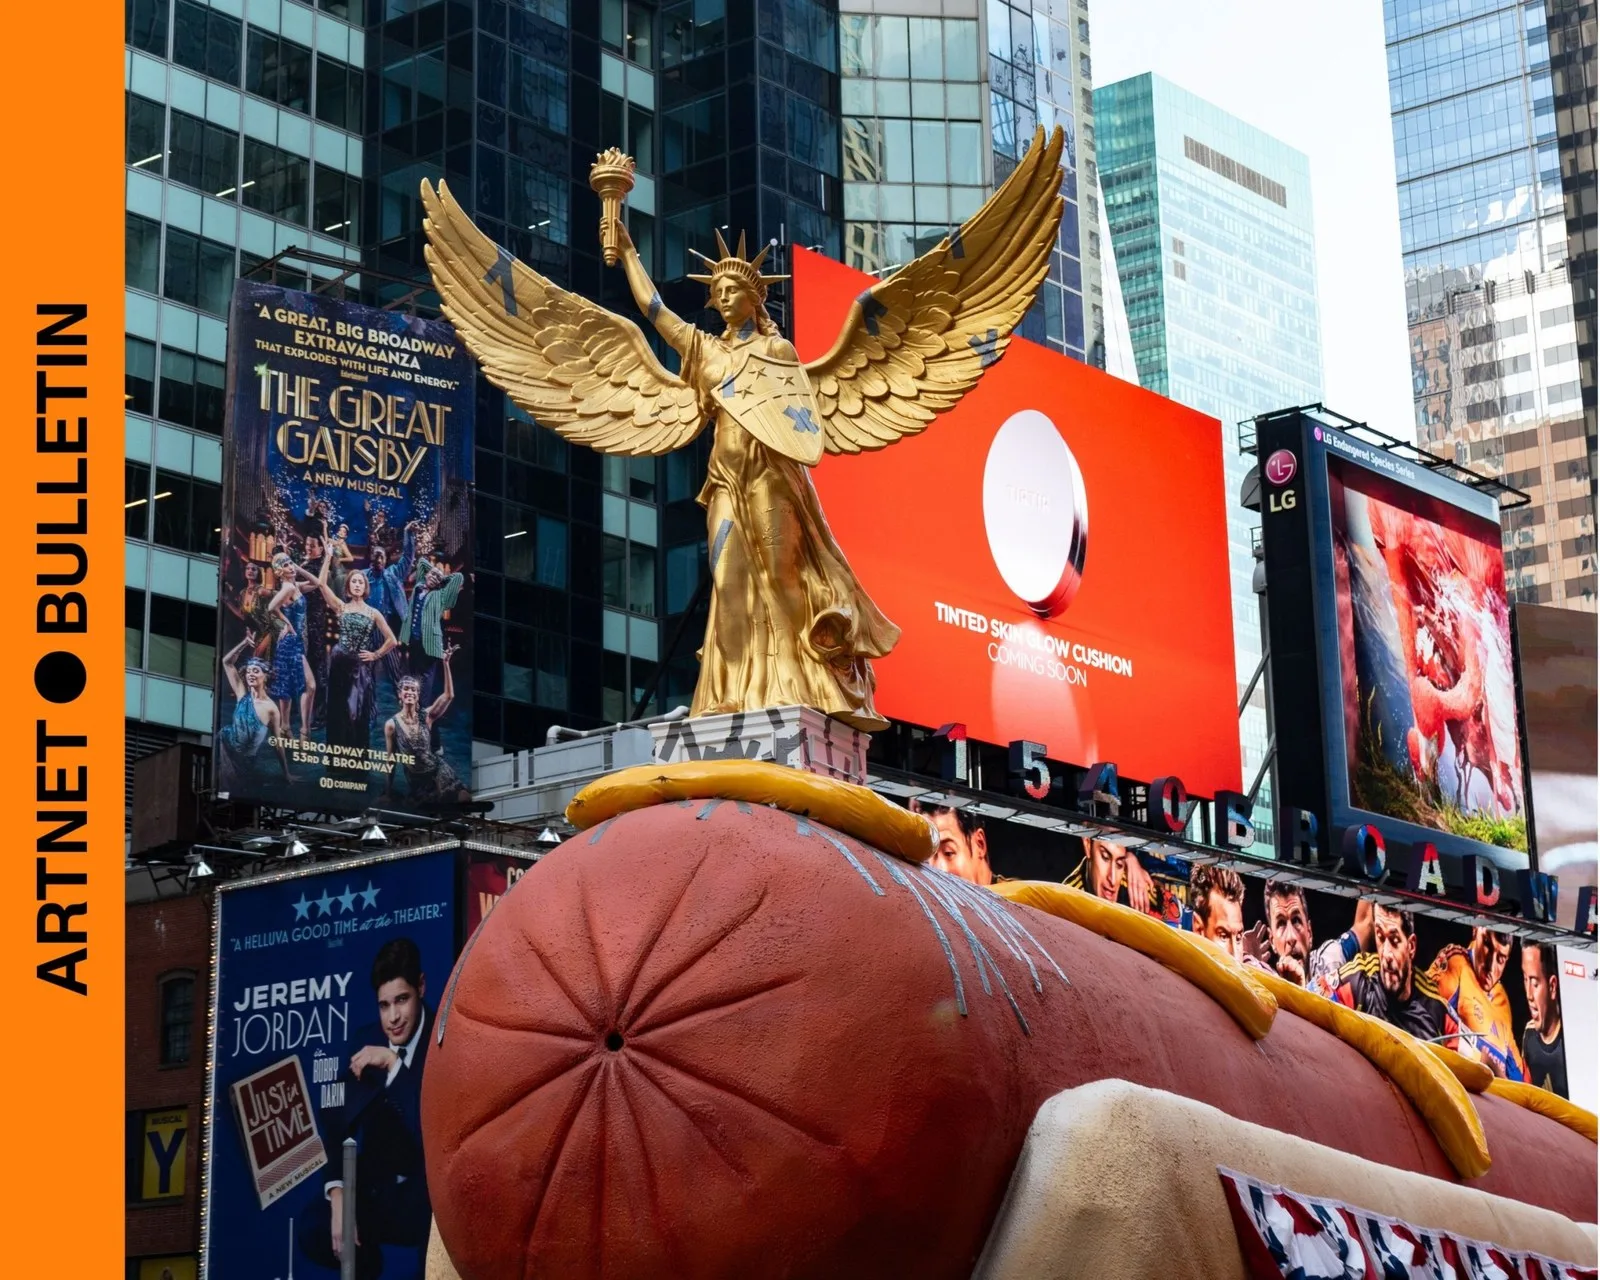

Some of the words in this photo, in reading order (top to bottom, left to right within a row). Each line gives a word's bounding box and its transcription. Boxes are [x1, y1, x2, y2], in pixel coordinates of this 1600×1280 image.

[254, 302, 271, 320] "A
[274, 308, 332, 335] GREAT,
[335, 321, 364, 340] BIG
[368, 328, 456, 360] BROADWAY
[294, 330, 421, 371] EXTRAVAGANZA
[255, 338, 283, 354] THAT
[284, 346, 338, 366] EXPLODES
[340, 357, 367, 373] WITH
[368, 361, 389, 377] LIFE
[390, 369, 413, 382] AND
[414, 374, 460, 391] ENERGY."
[254, 365, 320, 421] THE
[328, 385, 452, 447] GREAT
[276, 420, 428, 484] GATSBY
[1322, 431, 1332, 445] LG
[1333, 435, 1370, 462] Endangered
[1370, 452, 1395, 471] Species
[1395, 464, 1415, 480] Series
[303, 470, 313, 482] A
[315, 472, 345, 489] NEW
[347, 477, 404, 500] MUSICAL
[1269, 489, 1296, 512] LG
[934, 601, 988, 634] TINTED
[990, 618, 1025, 645] SKIN
[1026, 629, 1070, 659] GLOW
[1072, 643, 1132, 678] CUSHION
[987, 642, 1045, 675] COMING
[1047, 661, 1088, 688] SOON
[276, 737, 300, 750] THE
[302, 740, 365, 758] BROADWAY
[367, 749, 416, 766] THEATRE
[292, 751, 320, 764] 53RD
[321, 756, 330, 766] &
[332, 756, 395, 774] BROADWAY
[334, 780, 368, 792] COMPANY
[934, 723, 1187, 833] 1540
[244, 930, 289, 950] HELLUVA
[291, 923, 331, 942] GOOD
[333, 917, 358, 936] TIME
[359, 918, 373, 931] at
[374, 913, 393, 929] the
[393, 902, 448, 925] THEATER."
[233, 971, 353, 1012] JEREMY
[231, 1001, 349, 1057] JORDAN
[313, 1056, 339, 1083] BOBBY
[249, 1080, 288, 1127] JUST
[286, 1083, 299, 1102] in
[320, 1082, 345, 1109] DARIN
[249, 1102, 312, 1153] TIME
[147, 1128, 187, 1194] Y
[268, 1191, 275, 1200] A
[275, 1180, 294, 1196] NEW
[294, 1158, 324, 1180] MUSICAL
